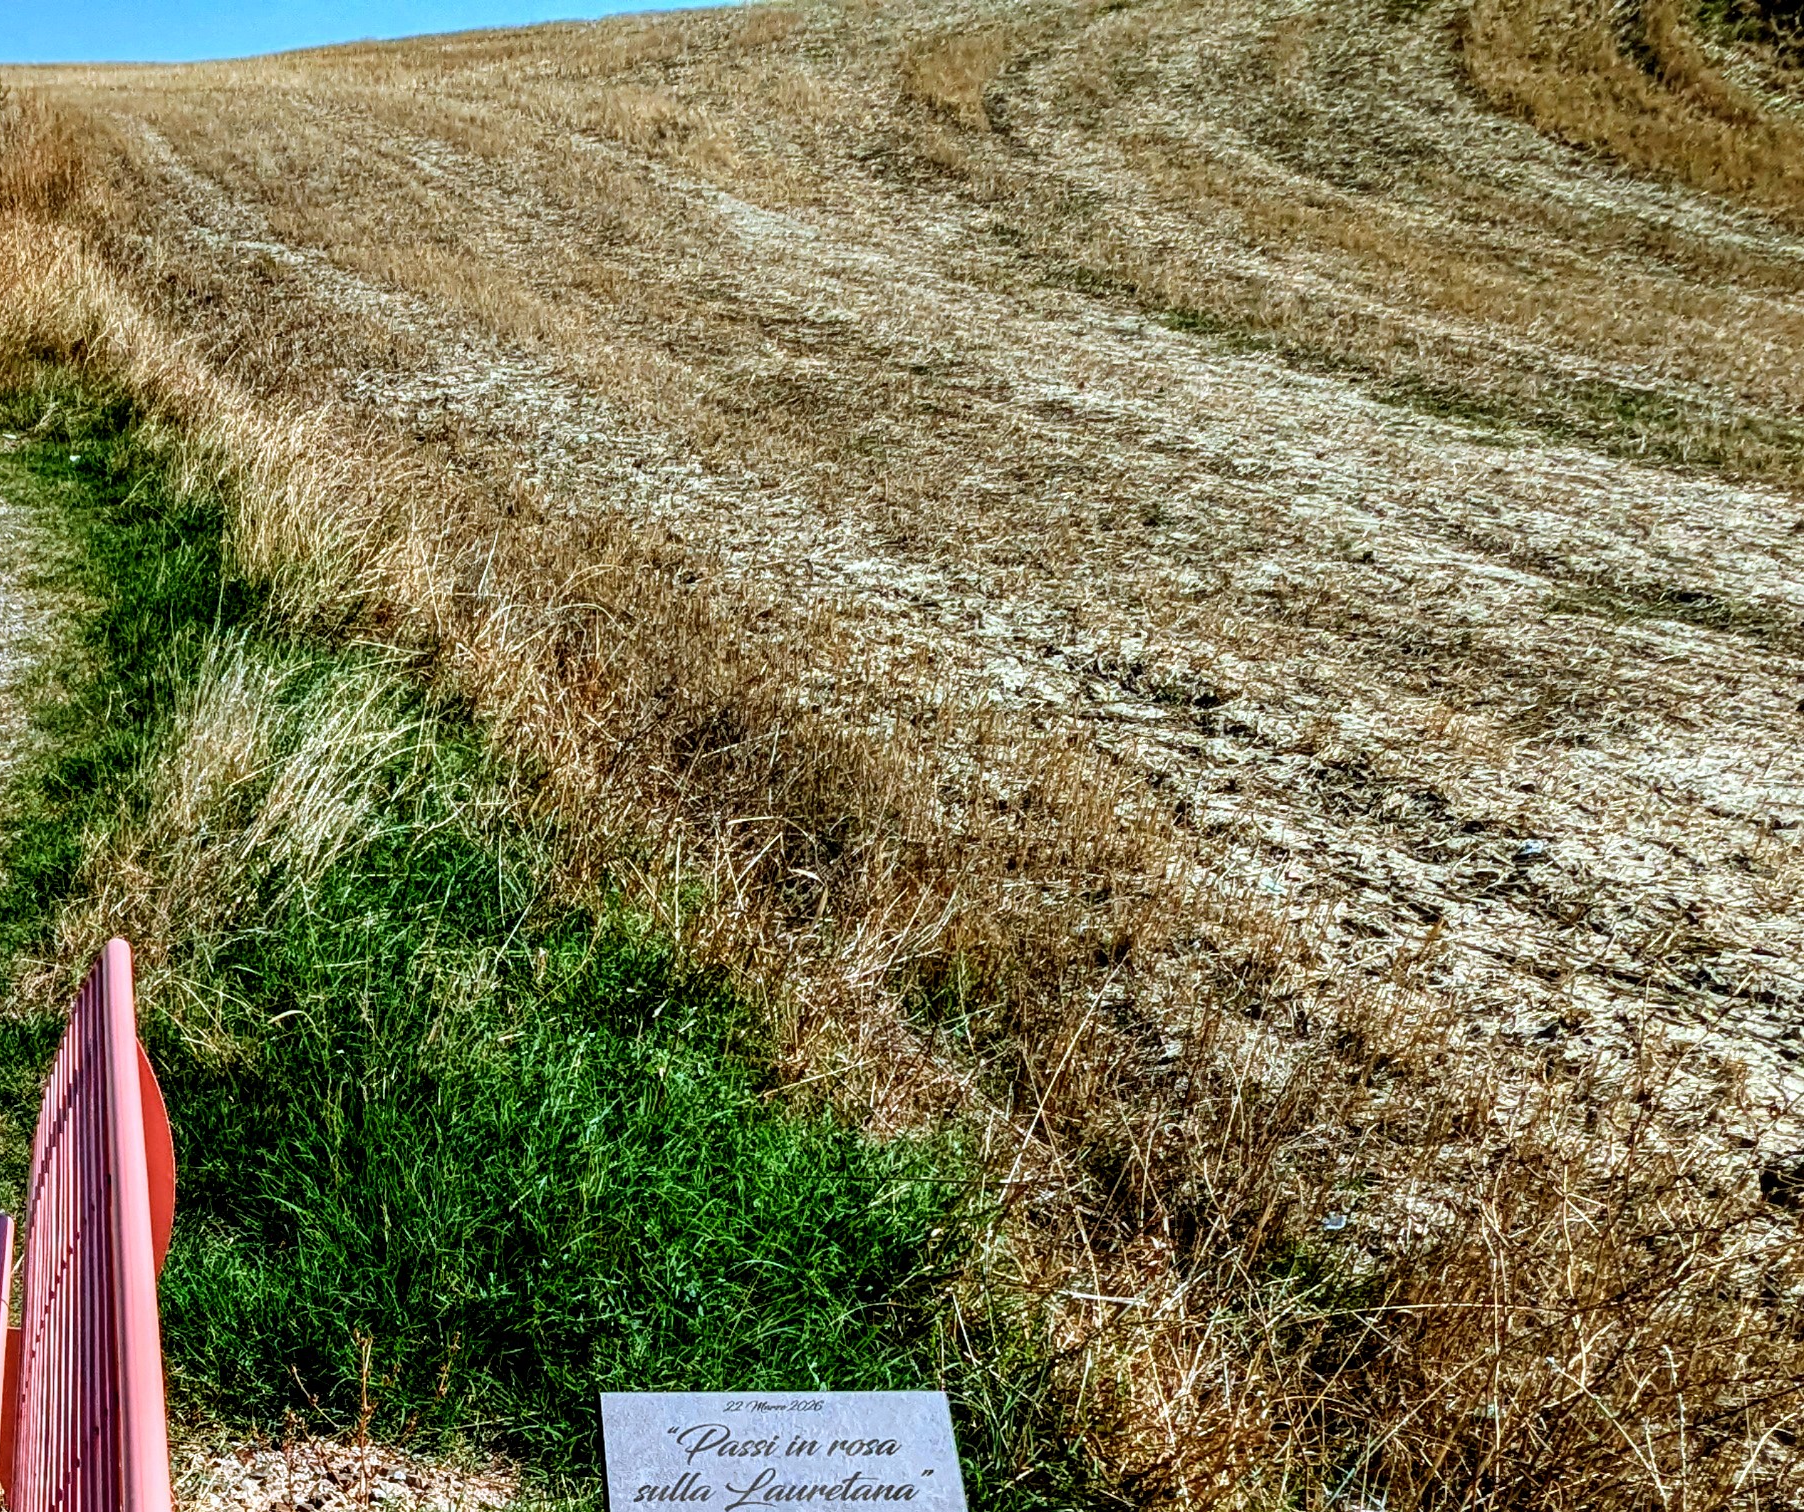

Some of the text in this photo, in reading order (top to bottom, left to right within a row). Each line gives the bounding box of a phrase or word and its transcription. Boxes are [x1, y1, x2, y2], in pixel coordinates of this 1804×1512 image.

[722, 1399, 825, 1414] 22 Marzo 2026
[784, 1434, 822, 1458] in
[826, 1438, 903, 1458] rosa
[633, 1472, 717, 1503] sulla
